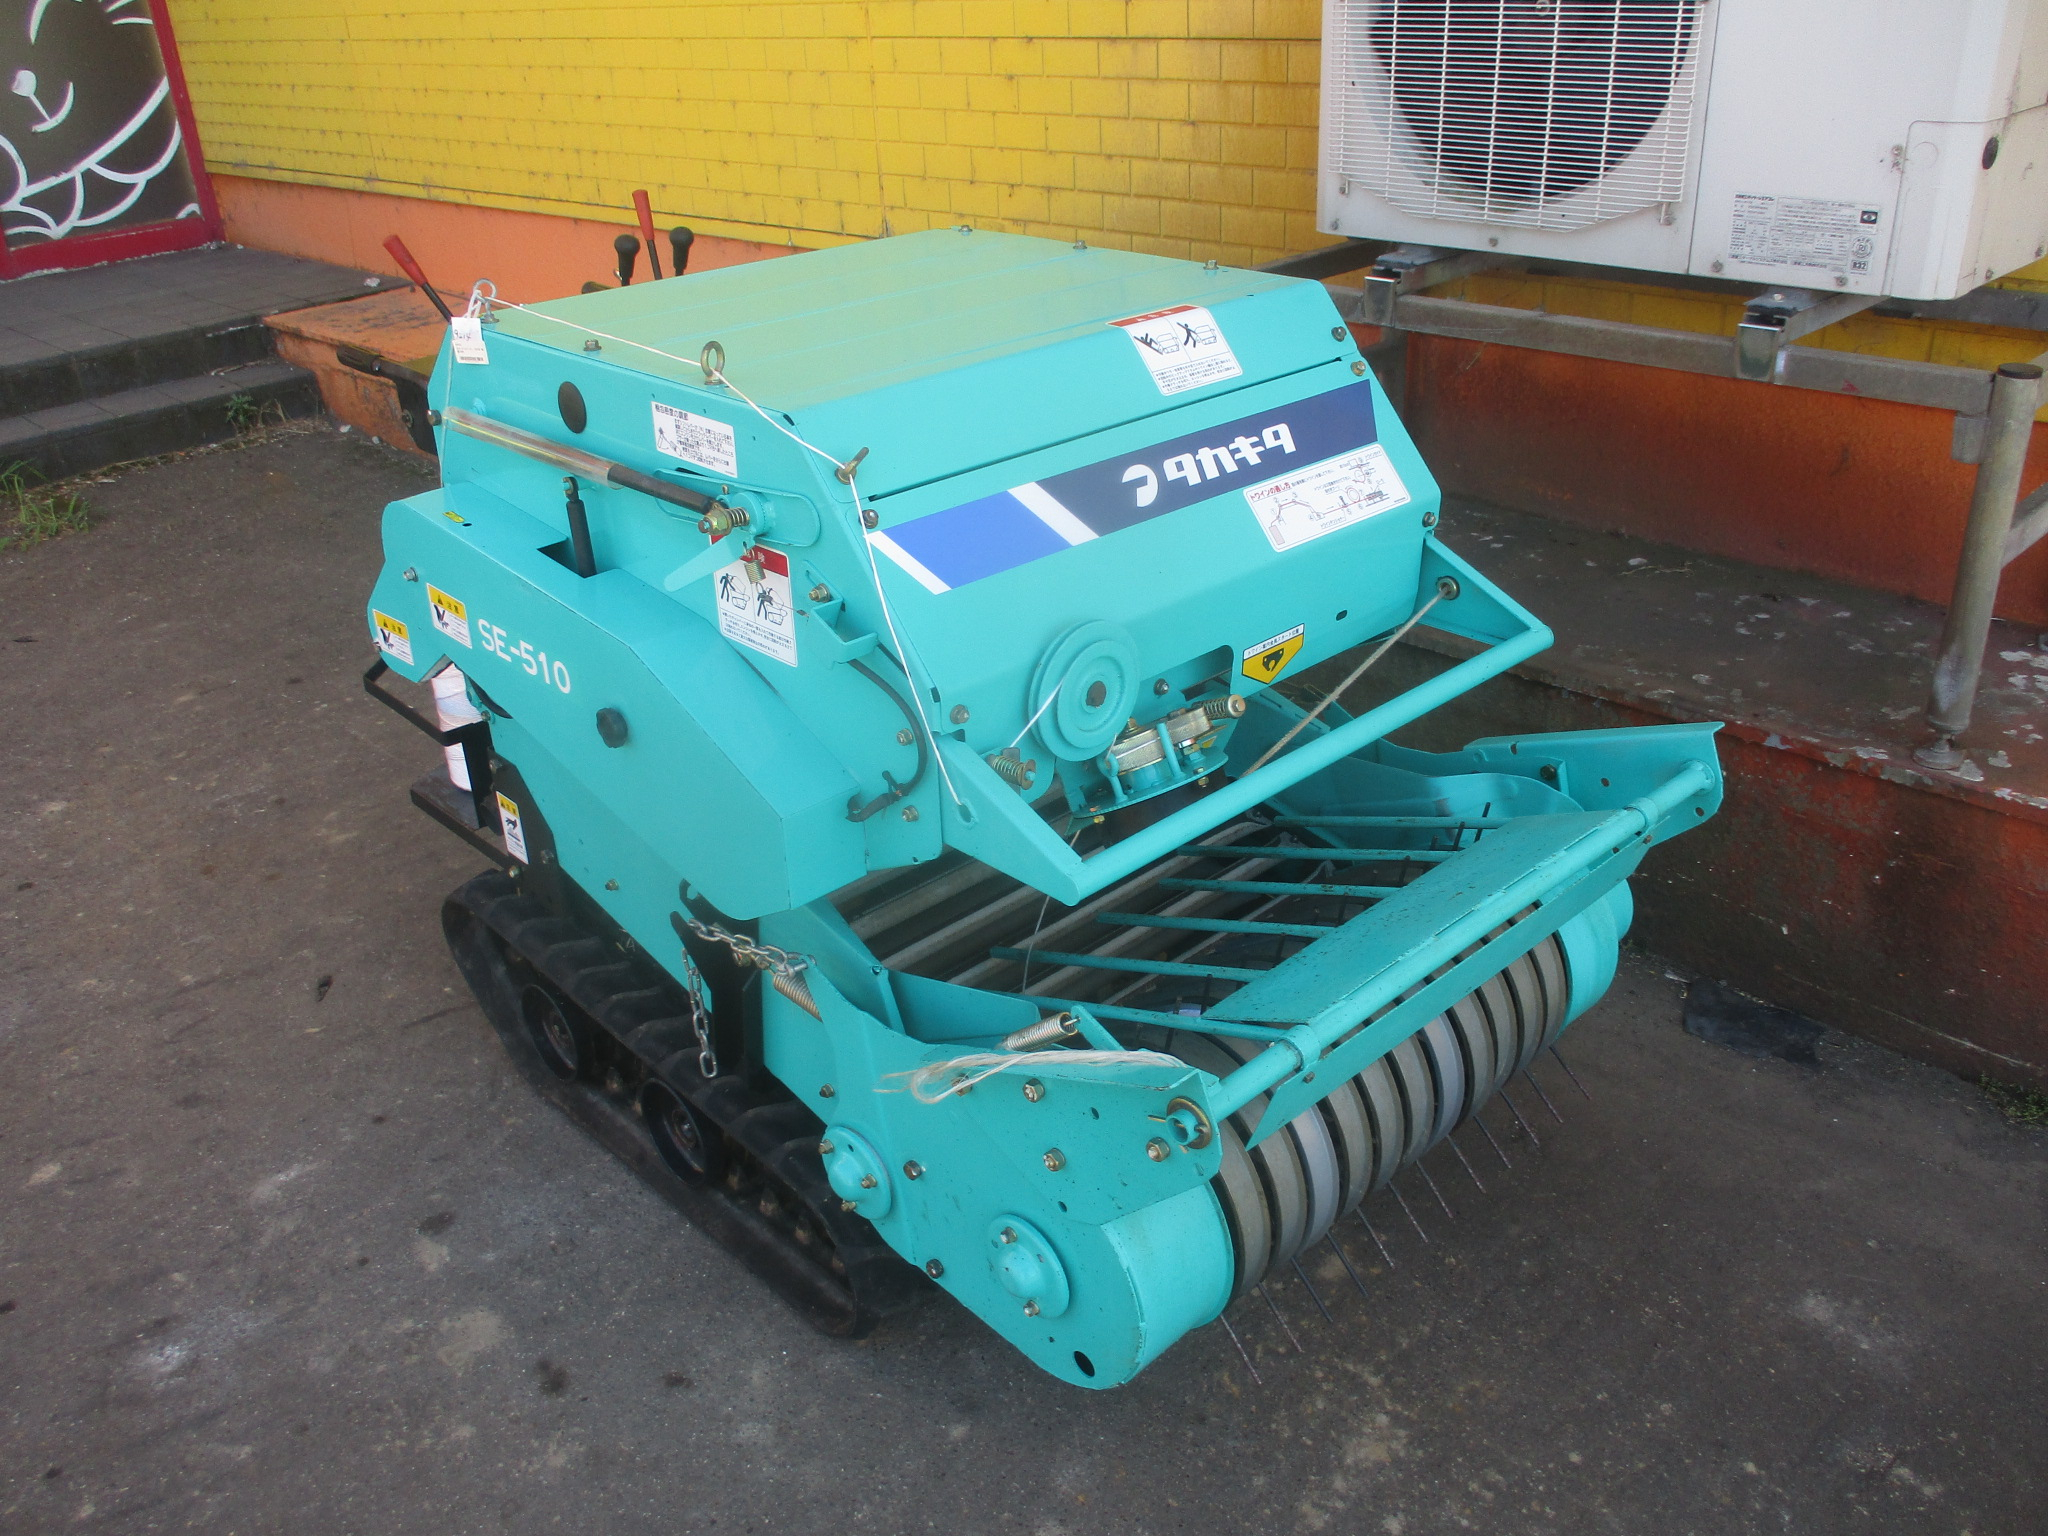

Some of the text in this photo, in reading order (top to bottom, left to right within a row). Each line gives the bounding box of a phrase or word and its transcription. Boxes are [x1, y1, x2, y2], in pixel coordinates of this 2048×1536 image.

[1163, 423, 1296, 486] タカキタ
[478, 618, 571, 694] SE-510
